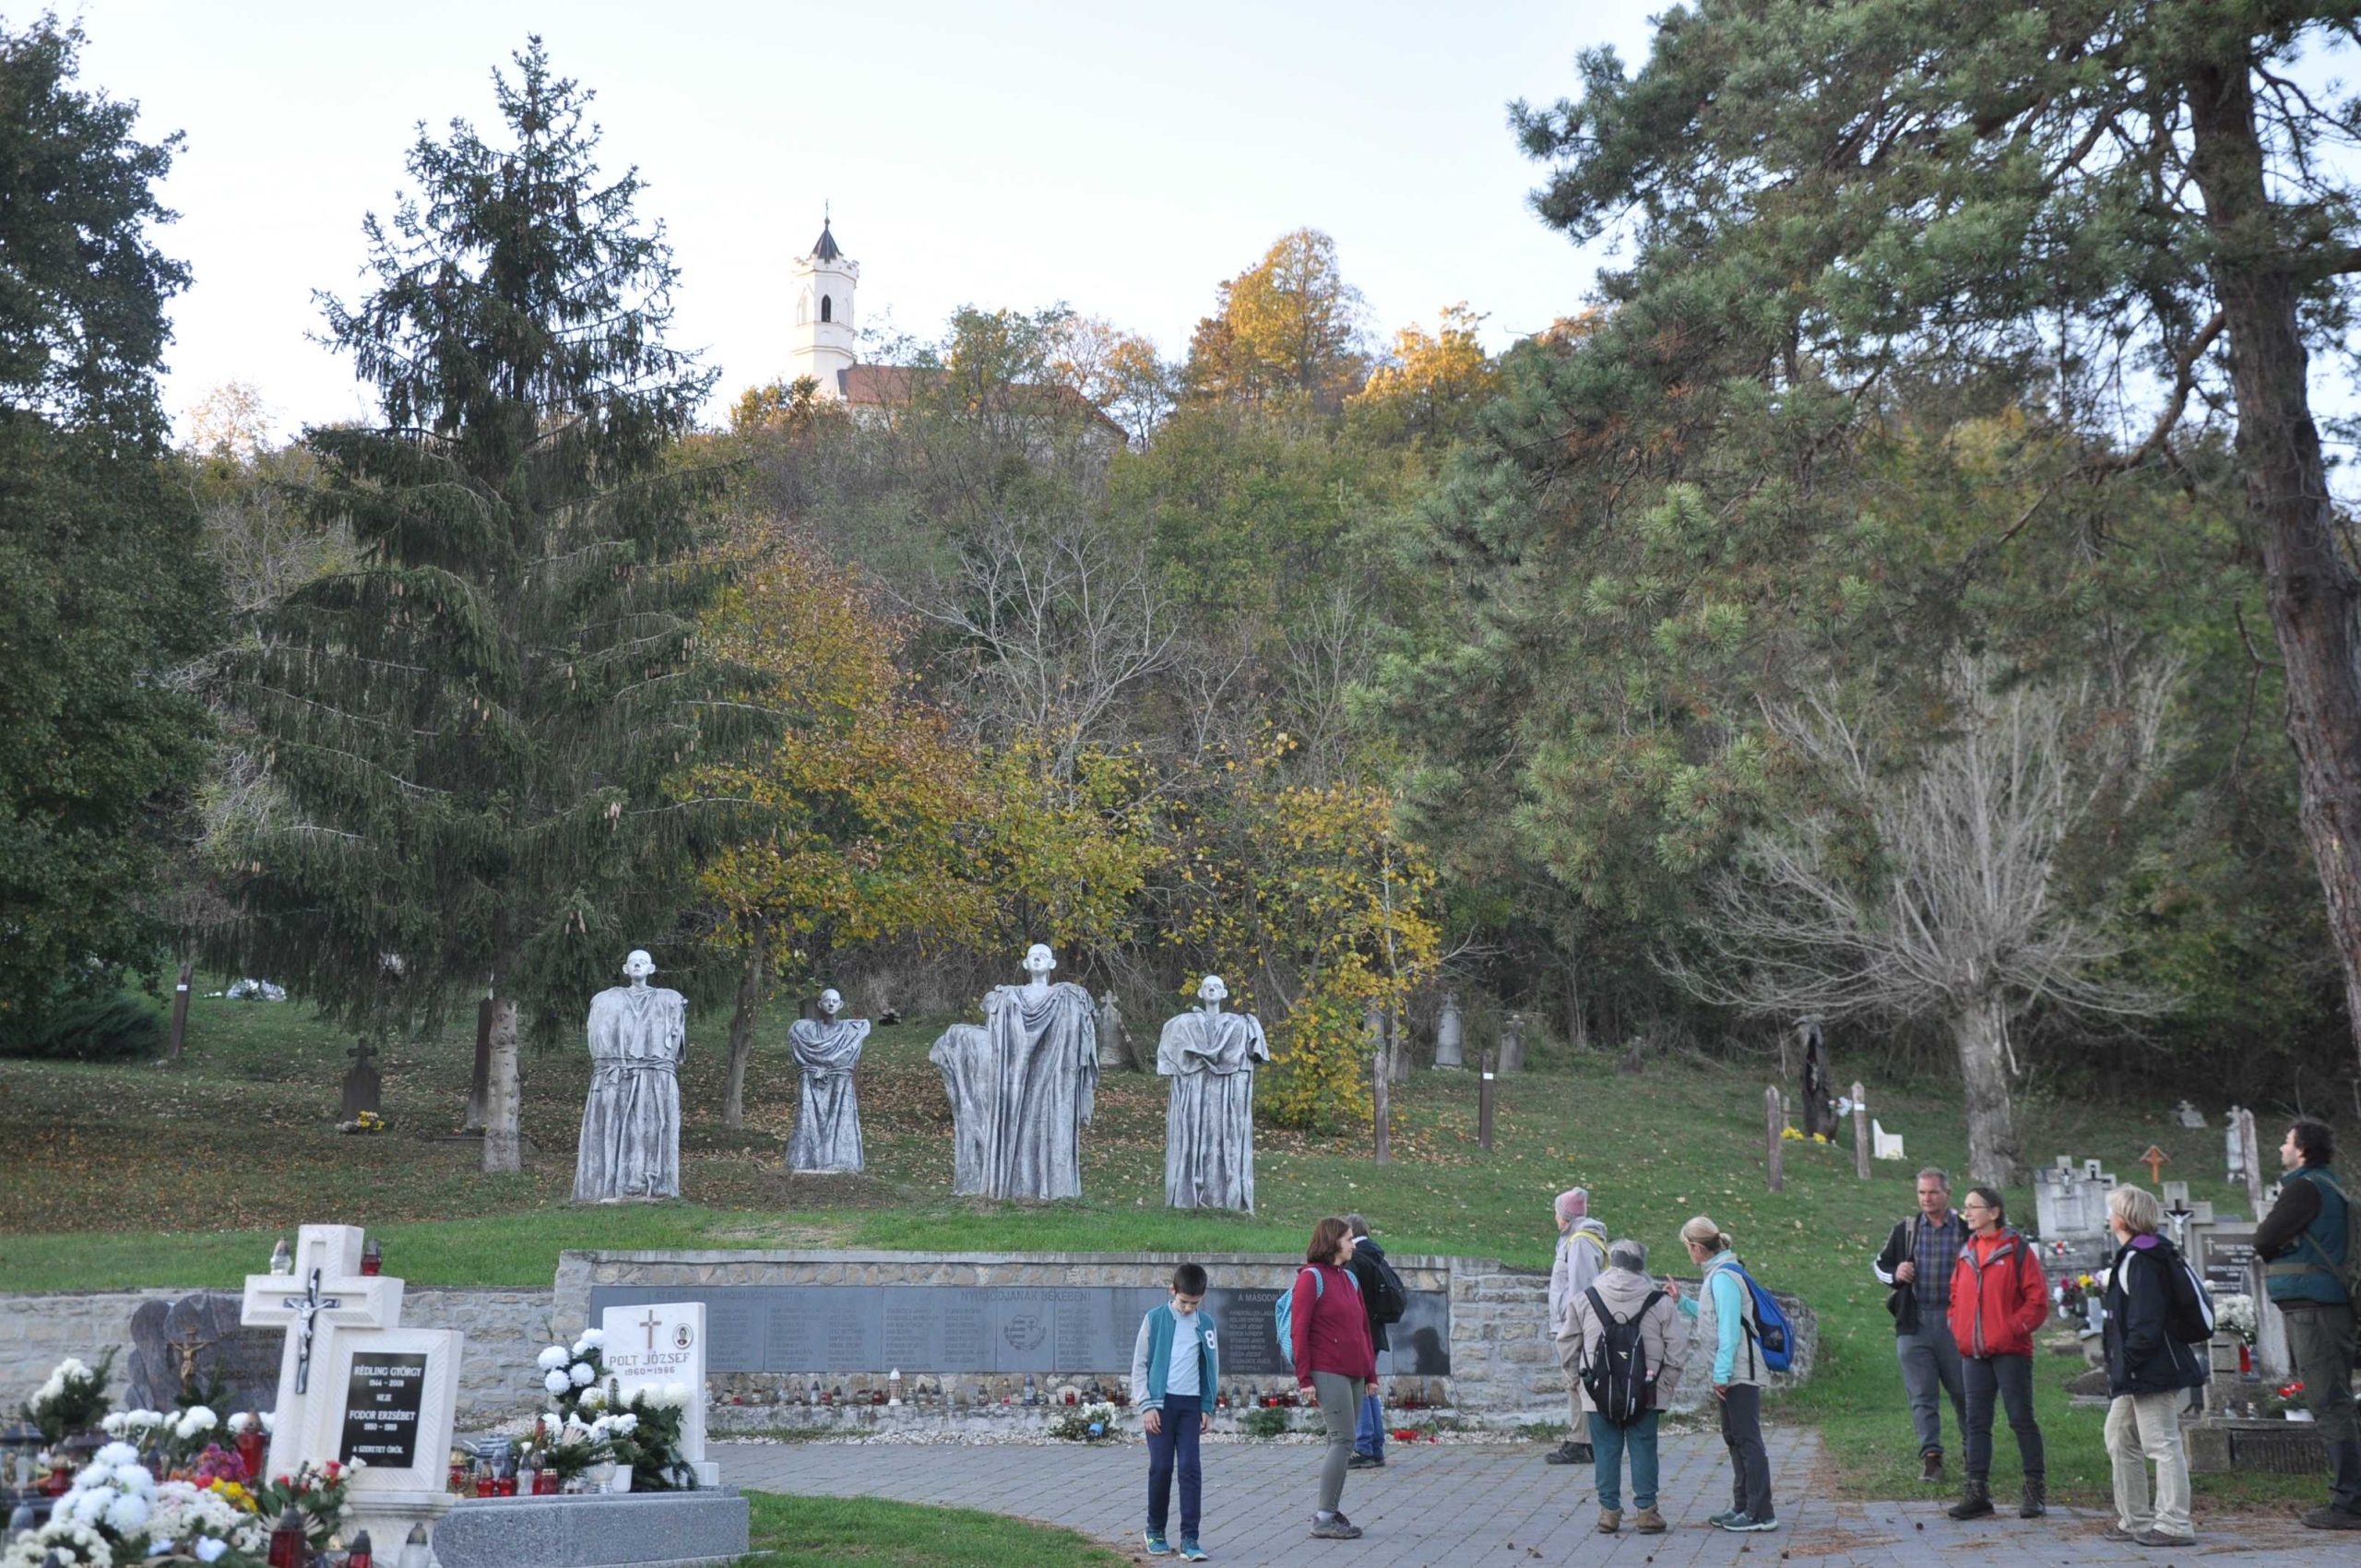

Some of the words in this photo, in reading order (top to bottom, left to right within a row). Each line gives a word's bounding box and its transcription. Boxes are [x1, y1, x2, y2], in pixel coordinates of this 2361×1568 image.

[1204, 1330, 1216, 1349] 8
[610, 1355, 638, 1366] POLT
[643, 1351, 691, 1365] JÓZSEF
[353, 1364, 388, 1376] RÉDLING
[389, 1365, 422, 1377] GYÖRGY
[349, 1410, 376, 1420] FODOR
[377, 1409, 416, 1420] ERZSÉBET
